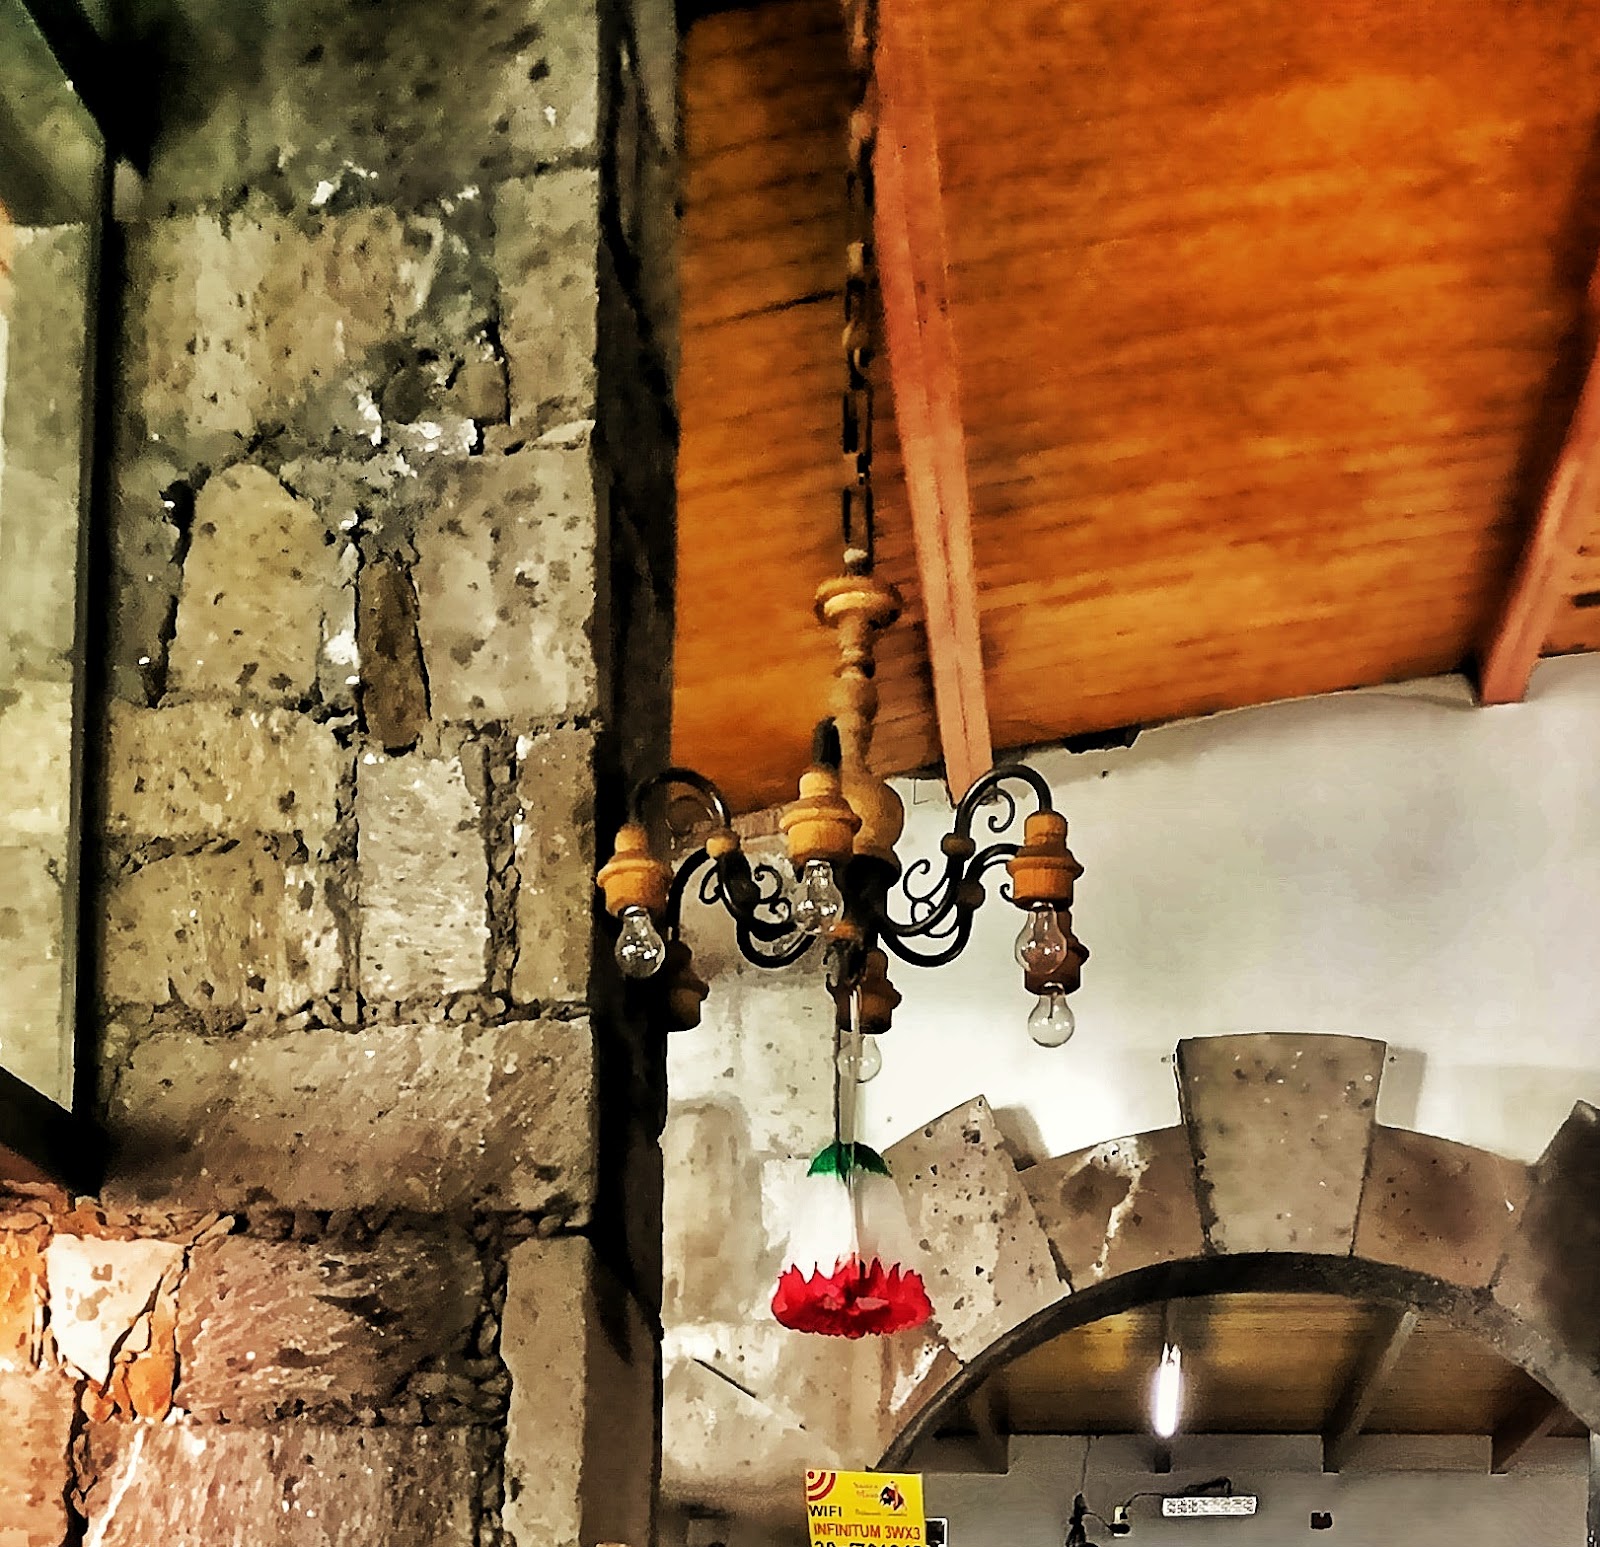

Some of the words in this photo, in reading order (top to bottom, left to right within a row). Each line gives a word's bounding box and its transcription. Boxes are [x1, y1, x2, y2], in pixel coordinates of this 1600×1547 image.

[809, 1505, 842, 1517] WIFI
[814, 1523, 881, 1538] INFINITUM
[885, 1525, 921, 1540] 3WX3
